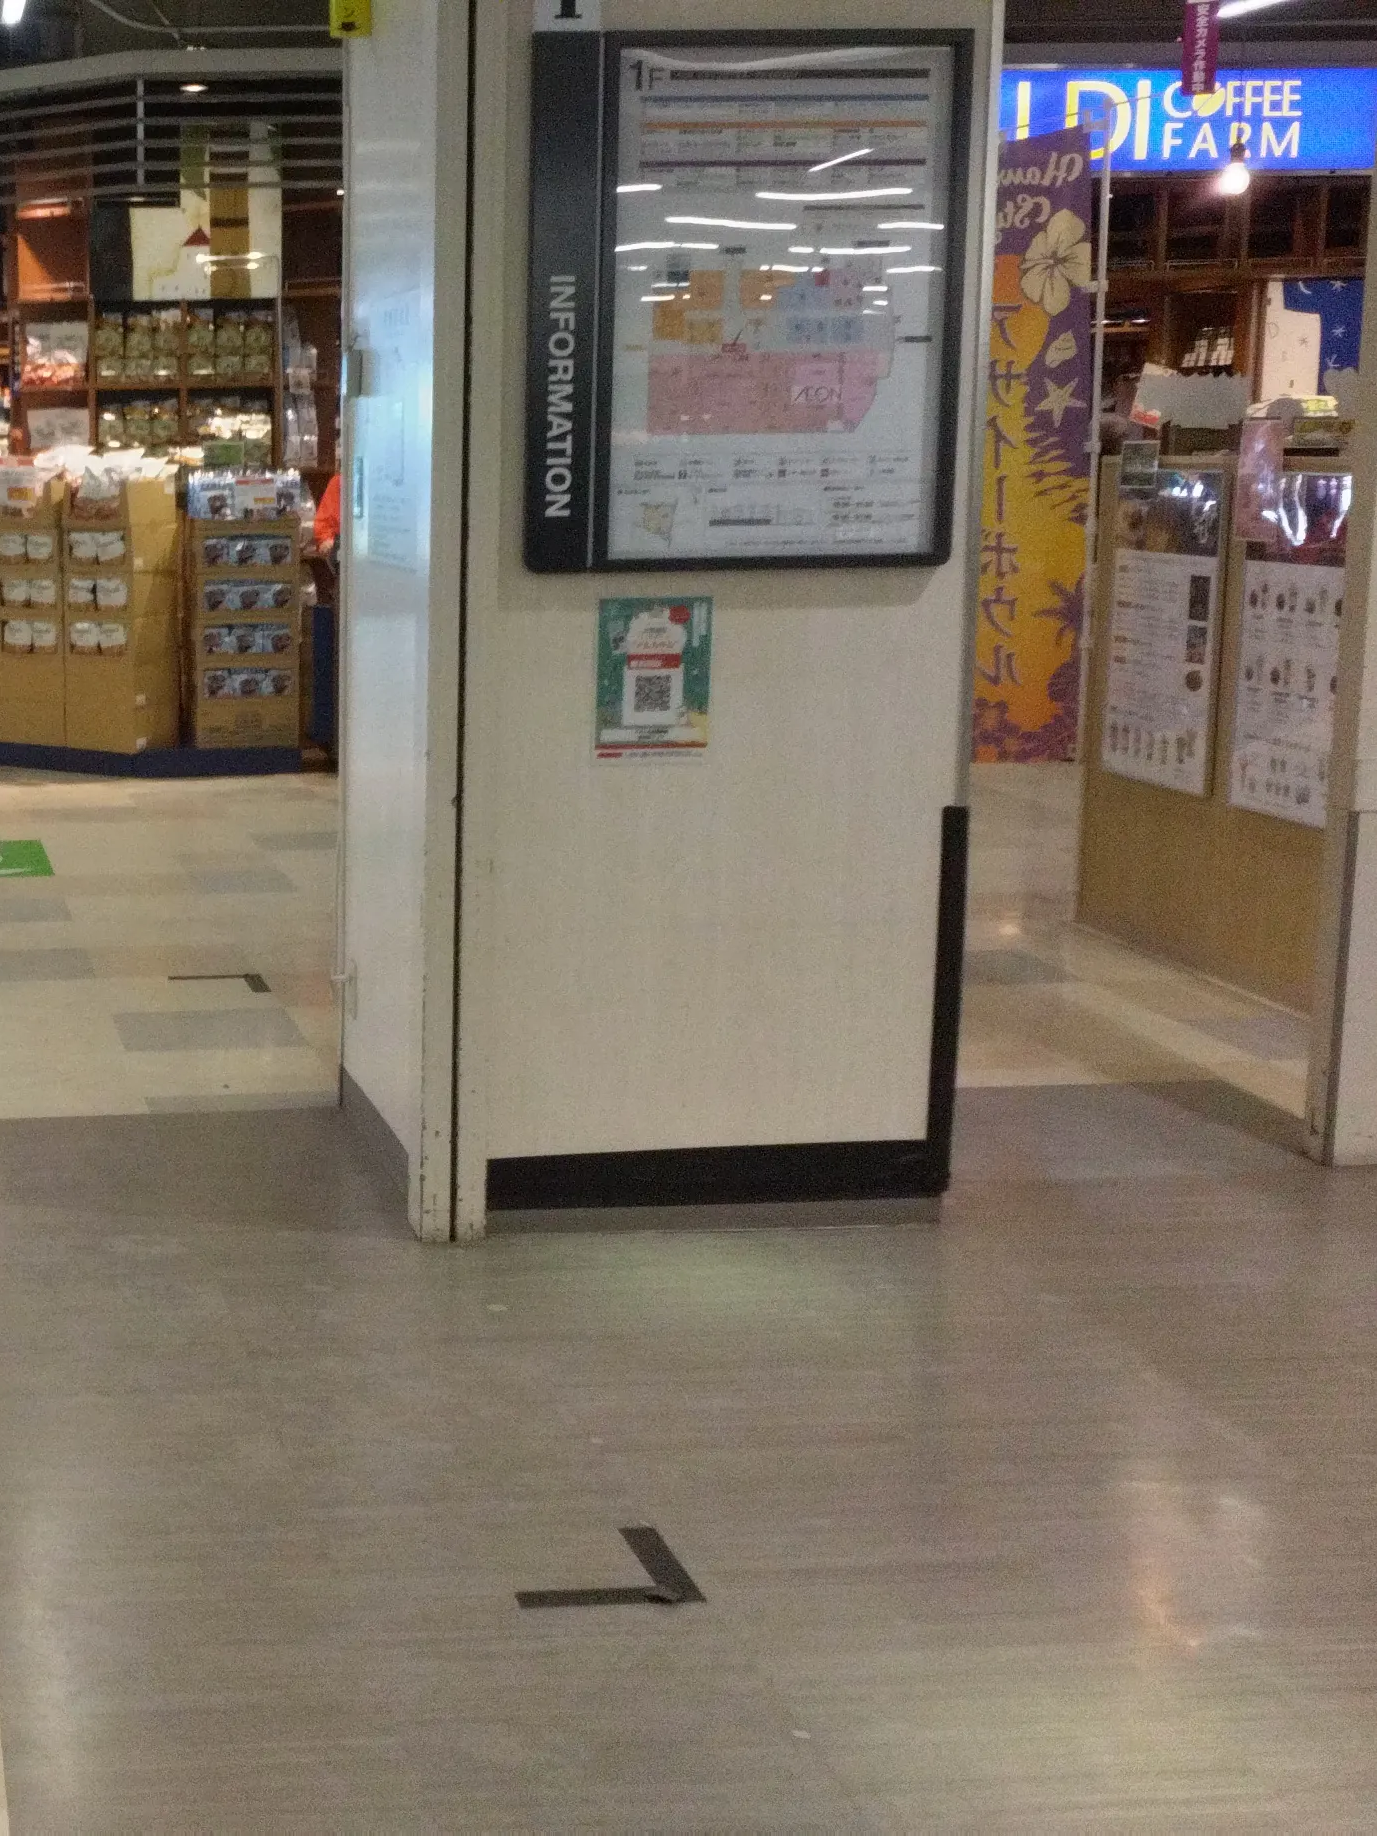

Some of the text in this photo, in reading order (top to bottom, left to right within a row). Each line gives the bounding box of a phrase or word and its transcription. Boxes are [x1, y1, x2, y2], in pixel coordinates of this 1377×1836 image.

[1163, 80, 1303, 118] COFFEE
[1162, 121, 1301, 159] FARM
[544, 274, 577, 519] INFORMATION
